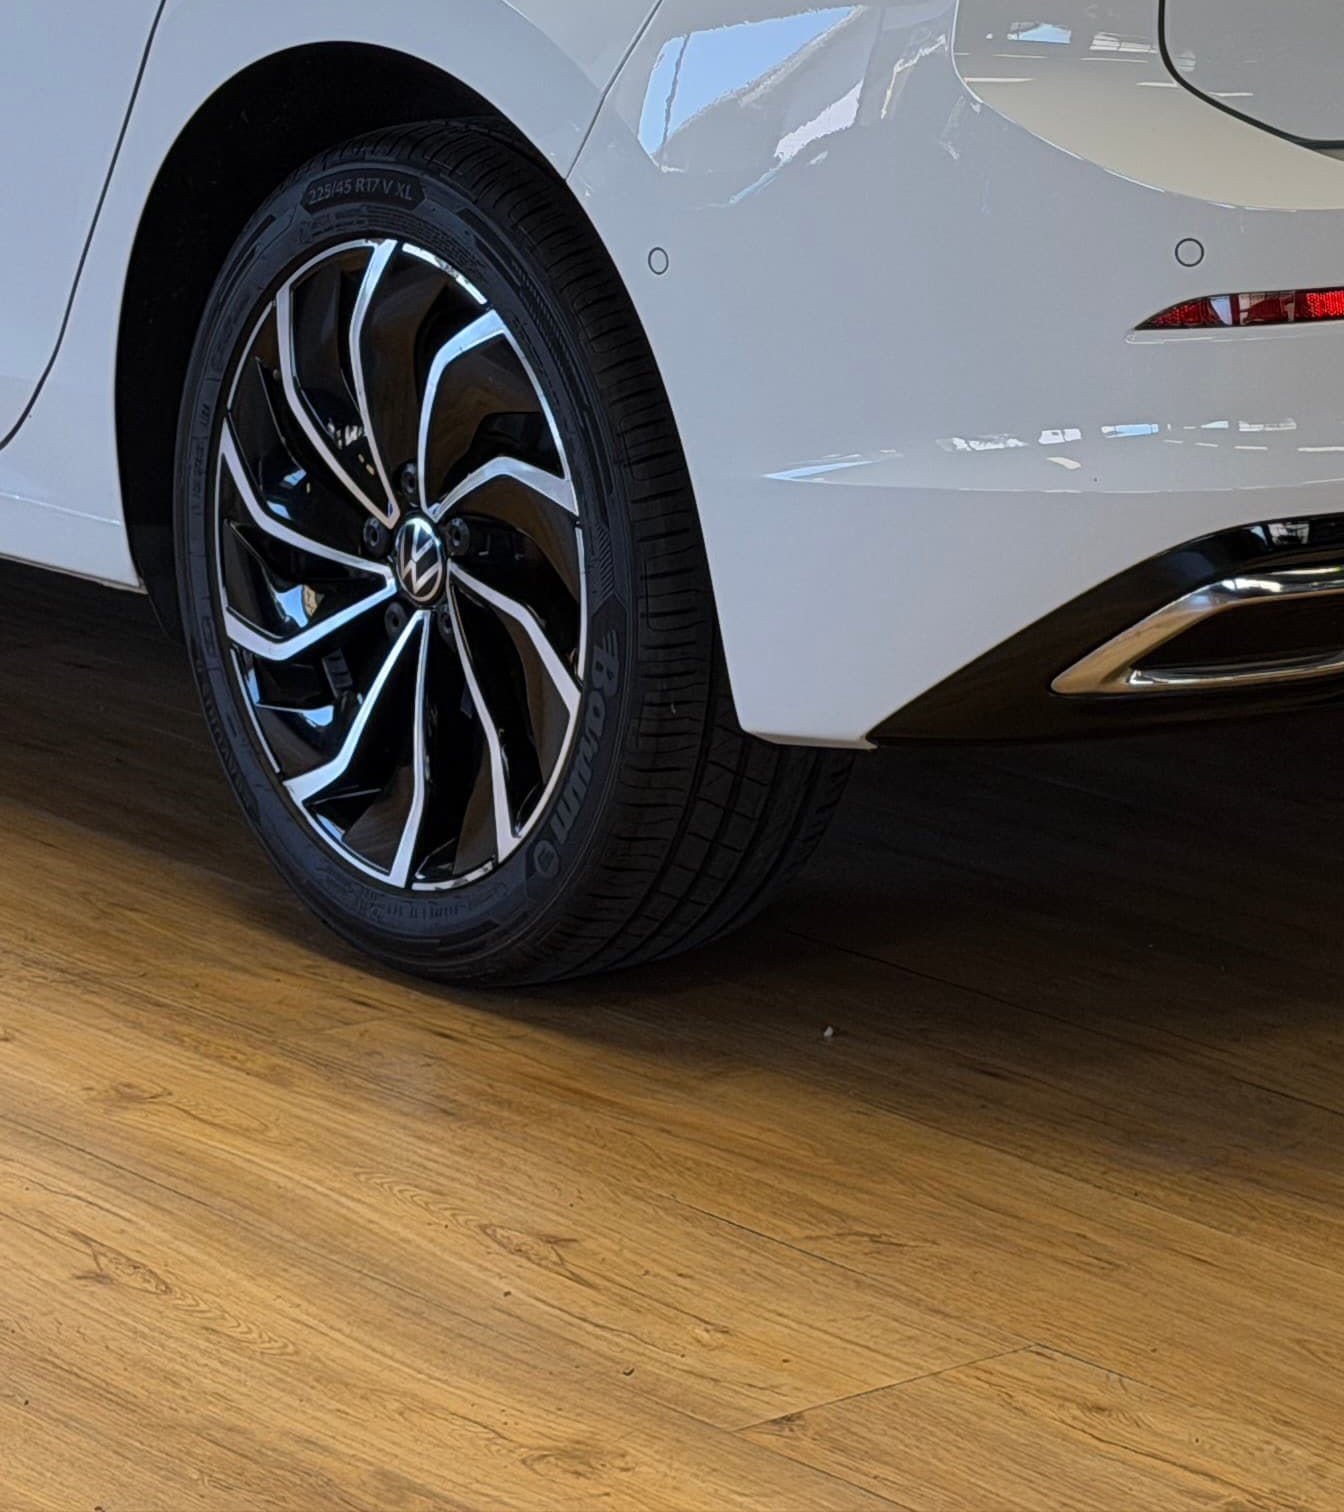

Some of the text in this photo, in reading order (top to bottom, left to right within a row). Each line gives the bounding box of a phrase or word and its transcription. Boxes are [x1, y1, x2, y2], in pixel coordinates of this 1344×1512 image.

[355, 176, 380, 193] R17
[383, 179, 394, 195] V
[395, 183, 413, 201] XL
[549, 628, 621, 844] Barum
